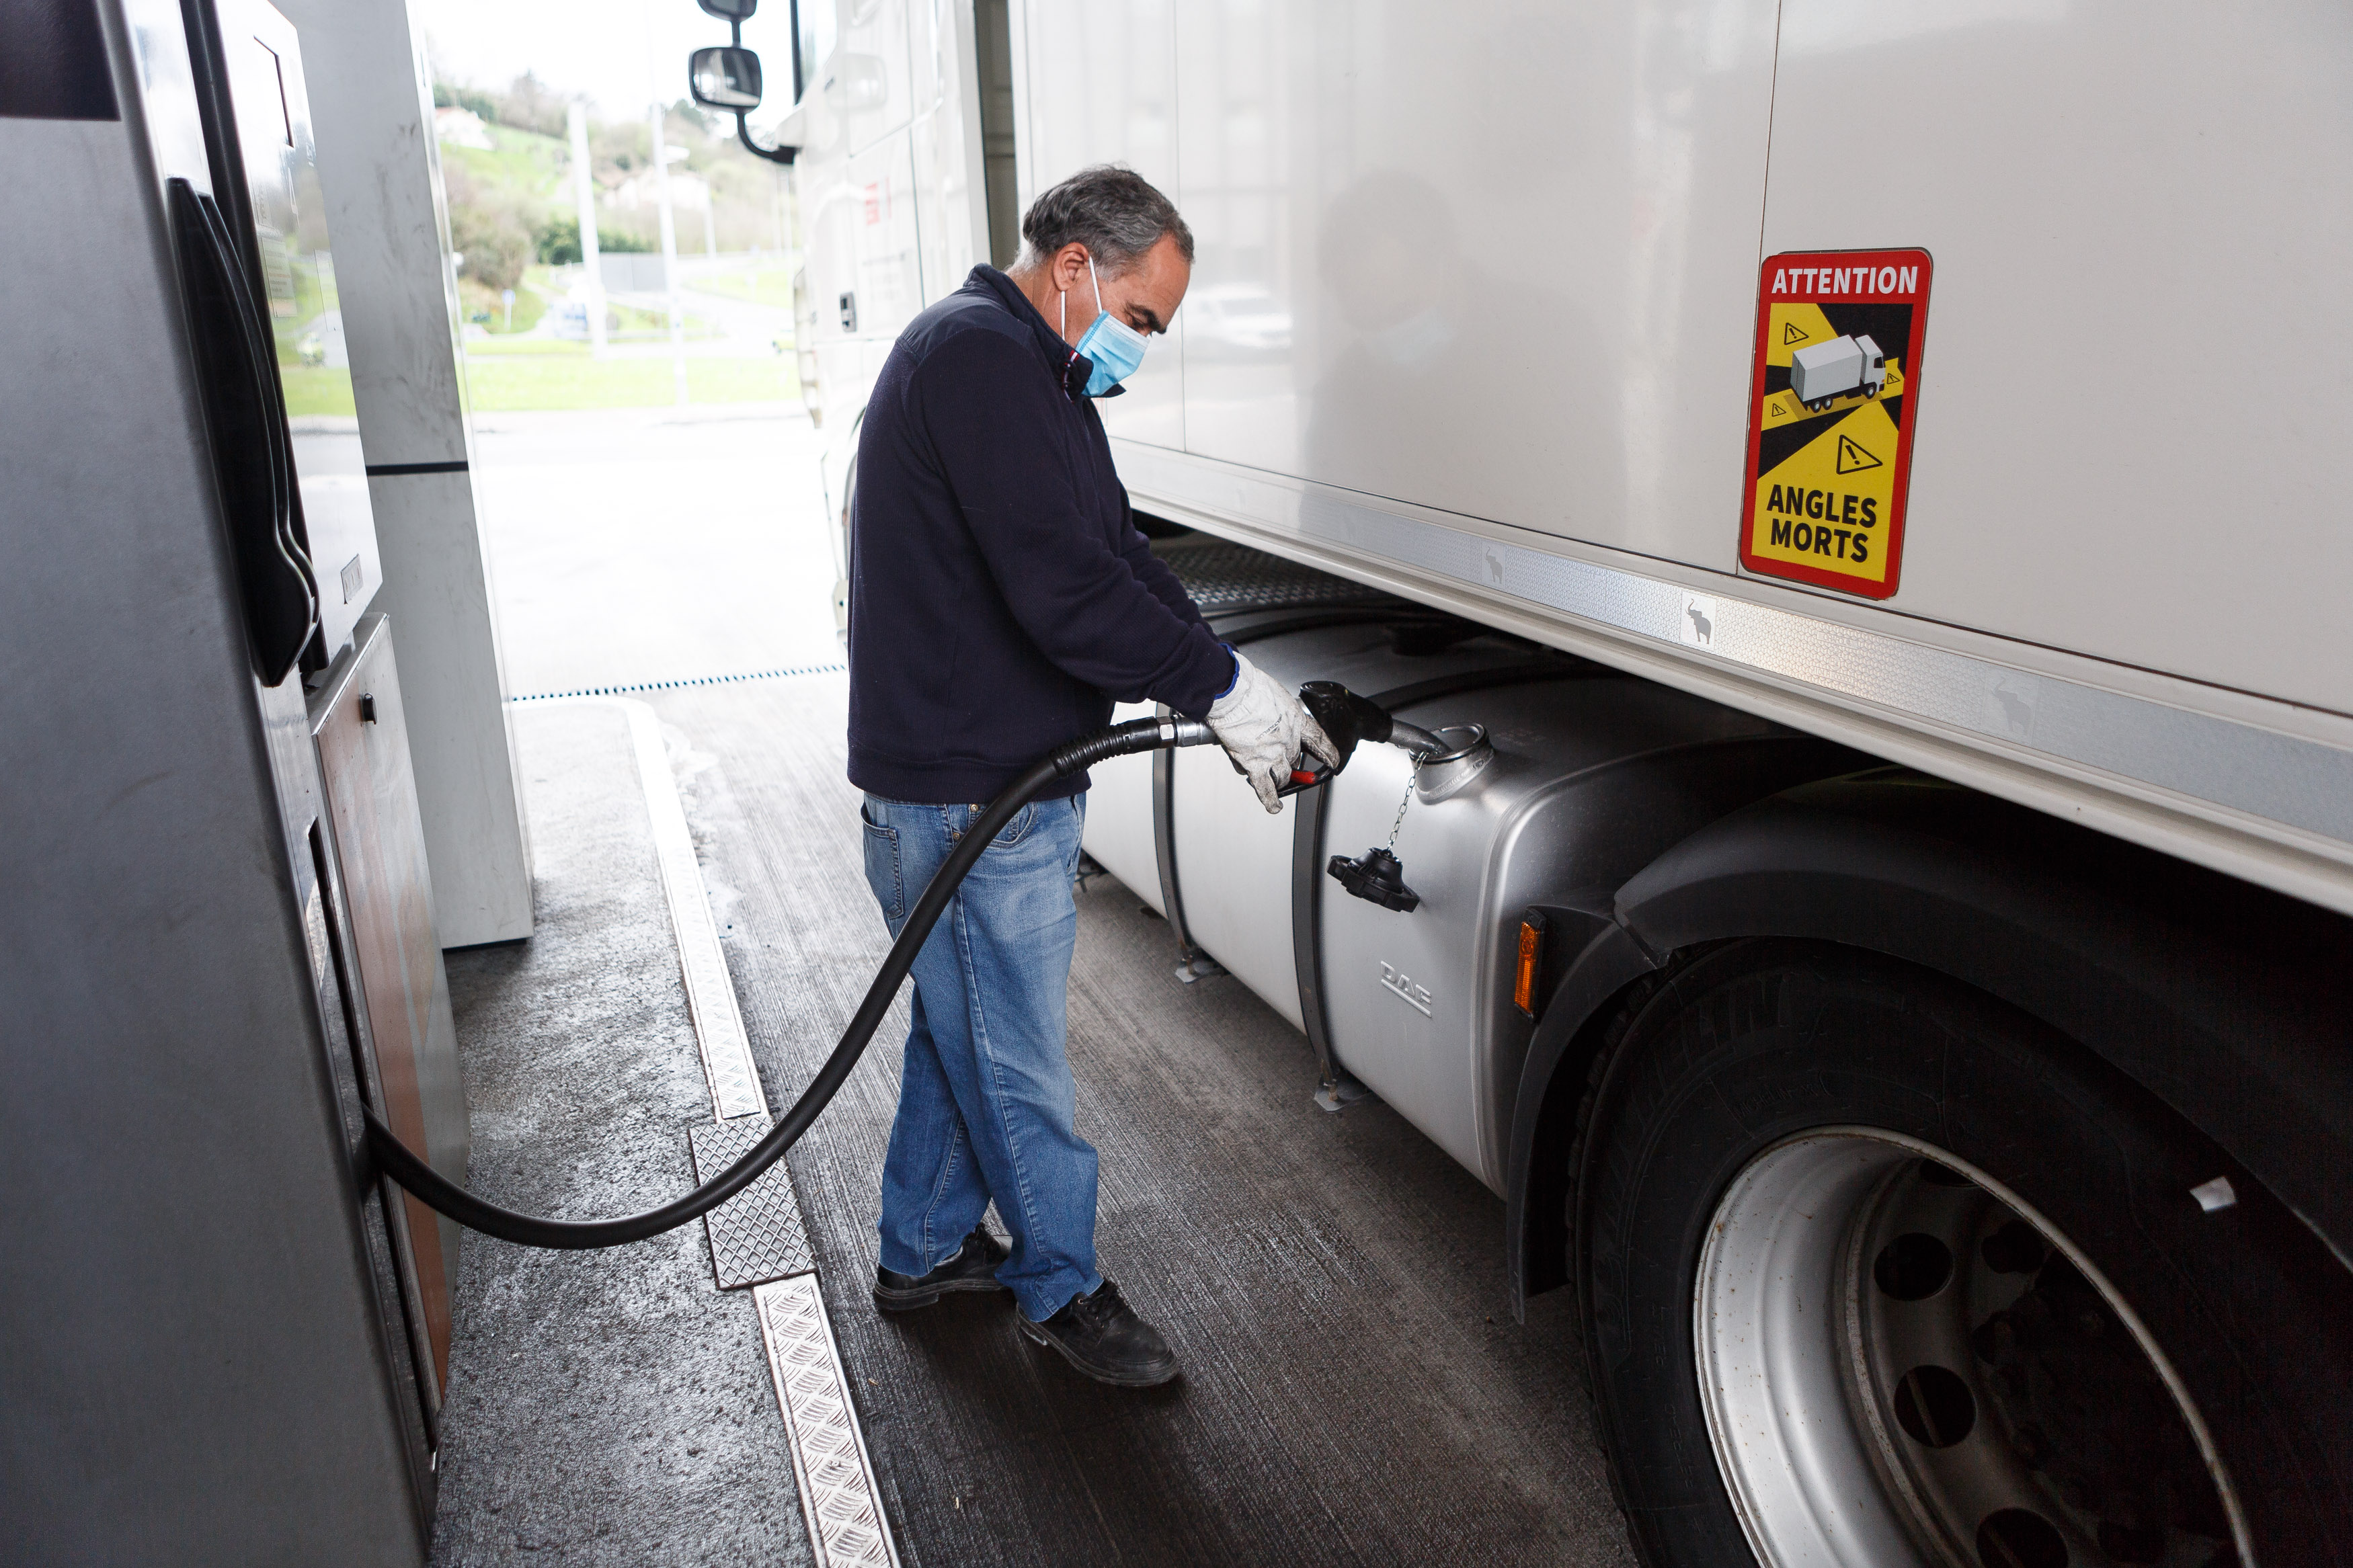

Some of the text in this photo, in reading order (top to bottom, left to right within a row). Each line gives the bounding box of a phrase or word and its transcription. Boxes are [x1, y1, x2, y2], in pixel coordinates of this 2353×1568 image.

[1771, 266, 1918, 294] ATTENTION
[1767, 484, 1877, 528] ANGLES
[1771, 518, 1868, 563] MORTS
[1380, 960, 1432, 1005] DAF
